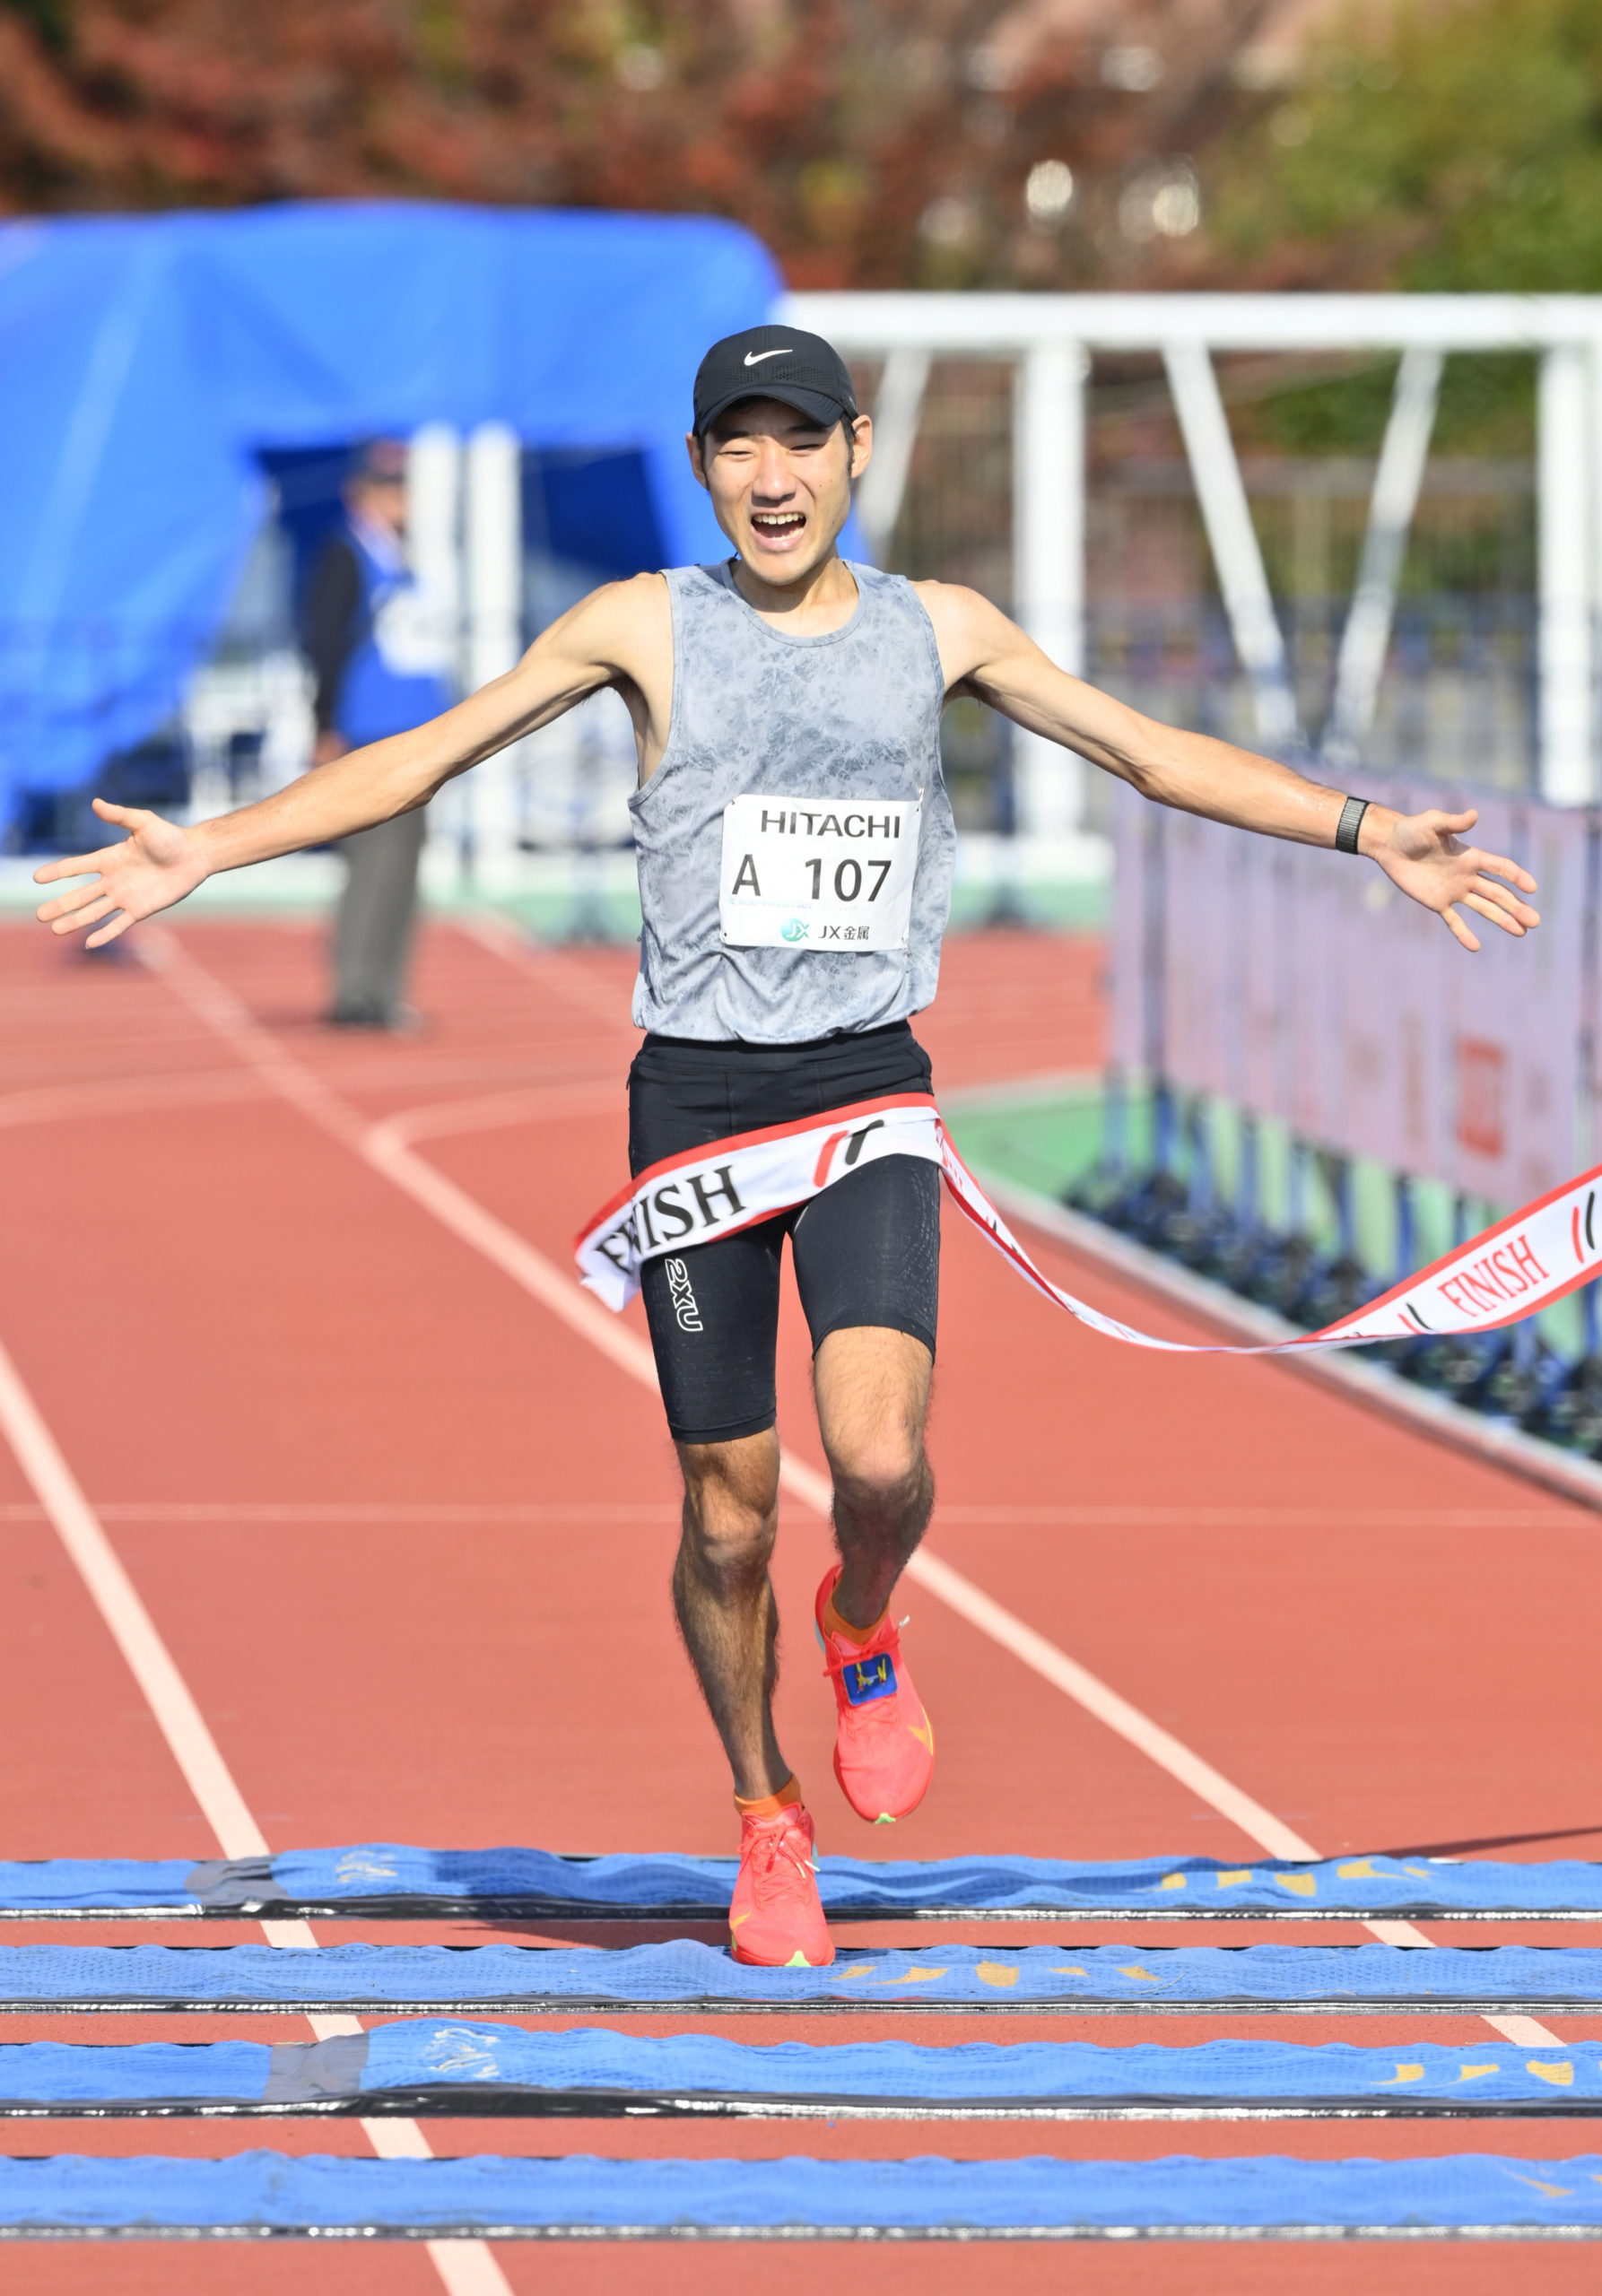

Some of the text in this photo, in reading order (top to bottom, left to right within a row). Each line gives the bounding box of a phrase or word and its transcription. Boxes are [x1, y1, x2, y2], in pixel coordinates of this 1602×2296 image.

[761, 809, 901, 839] HITACHI
[731, 853, 892, 902] A 107
[817, 925, 870, 941] JX金属
[665, 1258, 703, 1332] 2XU
[1437, 1234, 1551, 1318] FINISH
